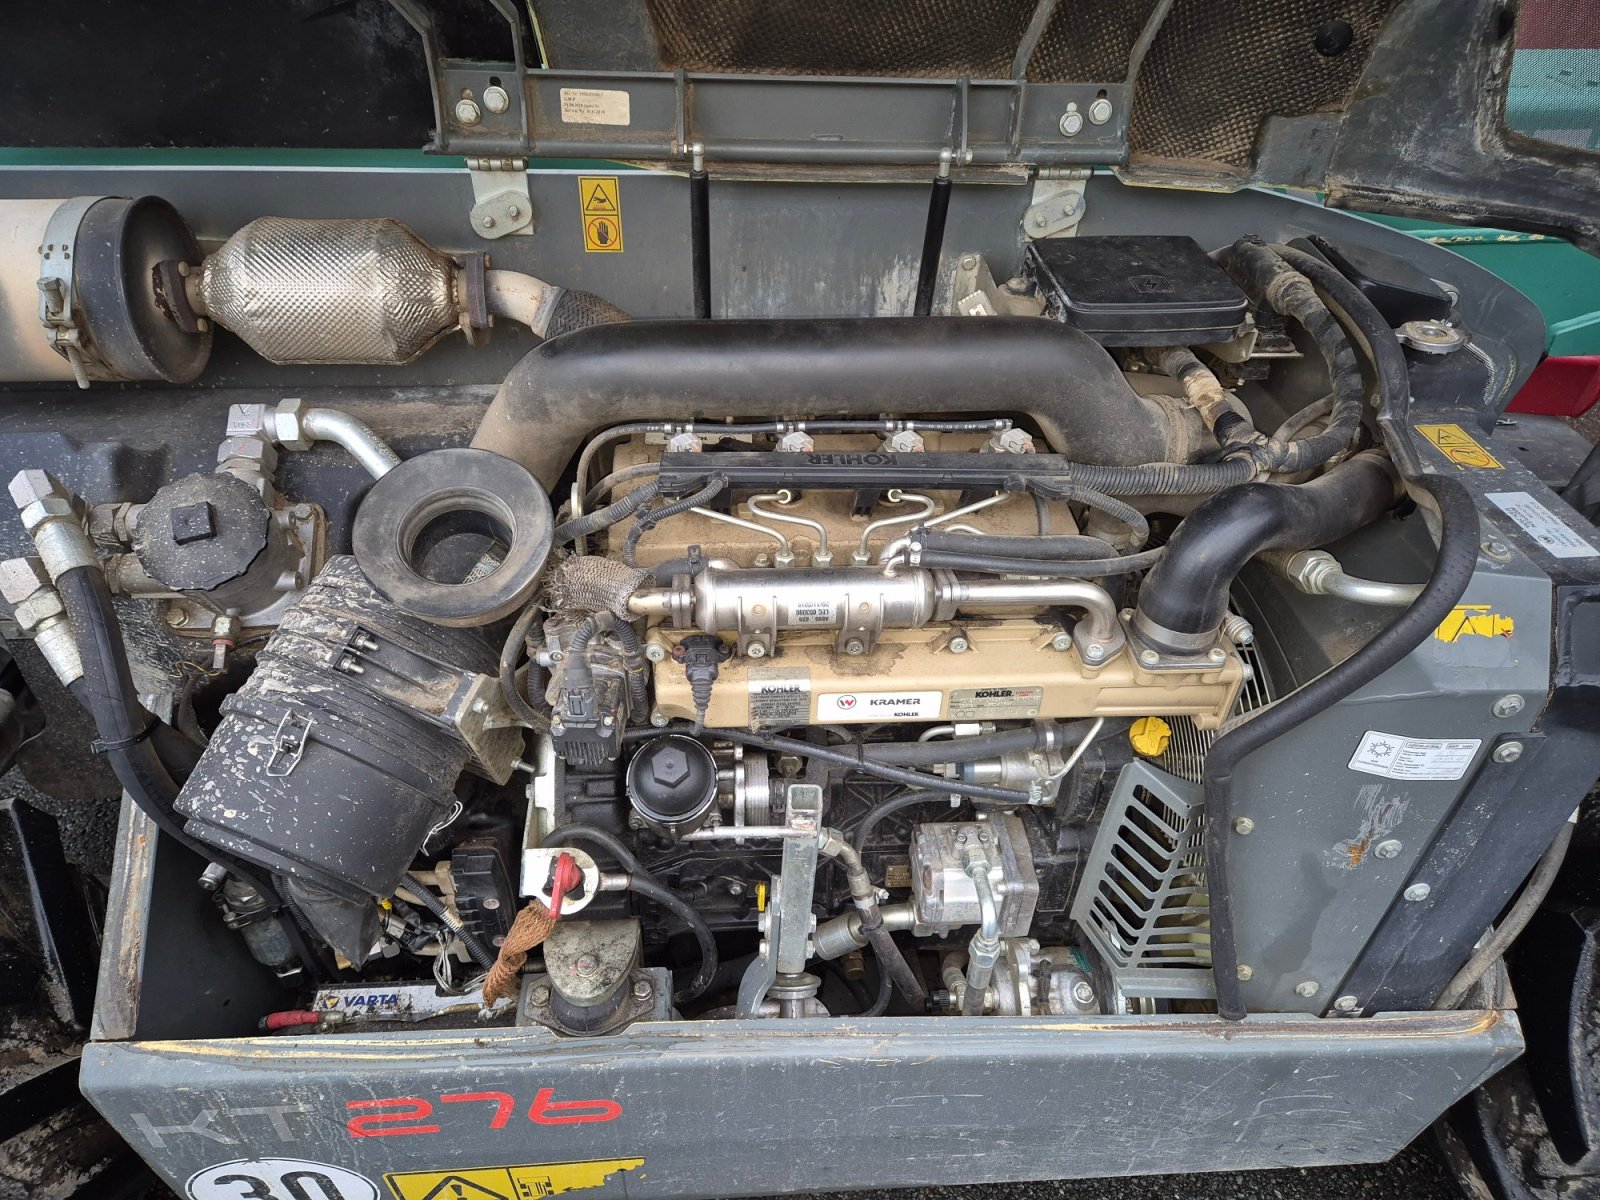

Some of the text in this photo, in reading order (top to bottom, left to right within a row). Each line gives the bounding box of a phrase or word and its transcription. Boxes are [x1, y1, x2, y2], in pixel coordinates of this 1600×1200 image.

[808, 453, 898, 466] KOHLER
[761, 684, 802, 694] KOHLER
[975, 690, 1013, 698] KOHLER
[870, 698, 921, 706] KRAMER
[344, 994, 398, 1007] VARTA
[130, 1087, 623, 1148] KT 276
